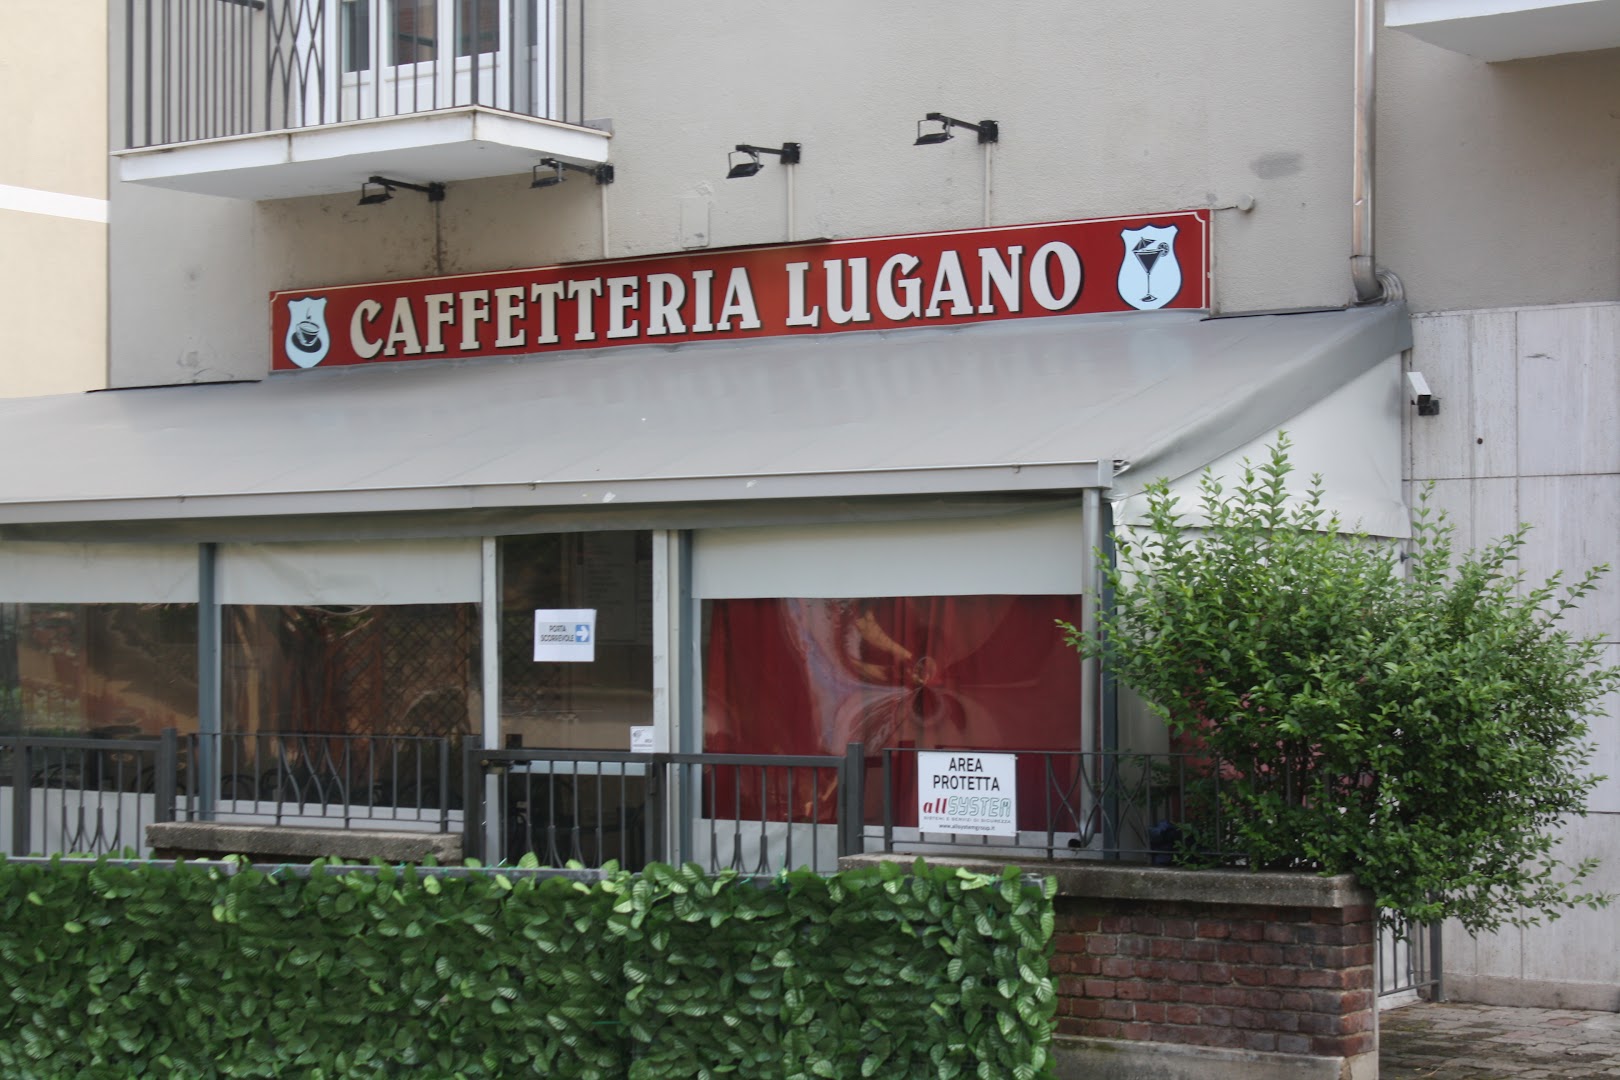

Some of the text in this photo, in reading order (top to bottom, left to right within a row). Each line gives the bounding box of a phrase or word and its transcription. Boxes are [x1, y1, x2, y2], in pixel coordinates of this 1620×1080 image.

[349, 241, 1083, 359] CAFFETTERIA LUGANO
[548, 625, 567, 633] PORTA
[540, 634, 575, 642] SCORREVOLE
[948, 757, 983, 772] AREA
[933, 775, 1000, 791] PROTETTA
[939, 823, 996, 832] www.allsystemgroup.it
